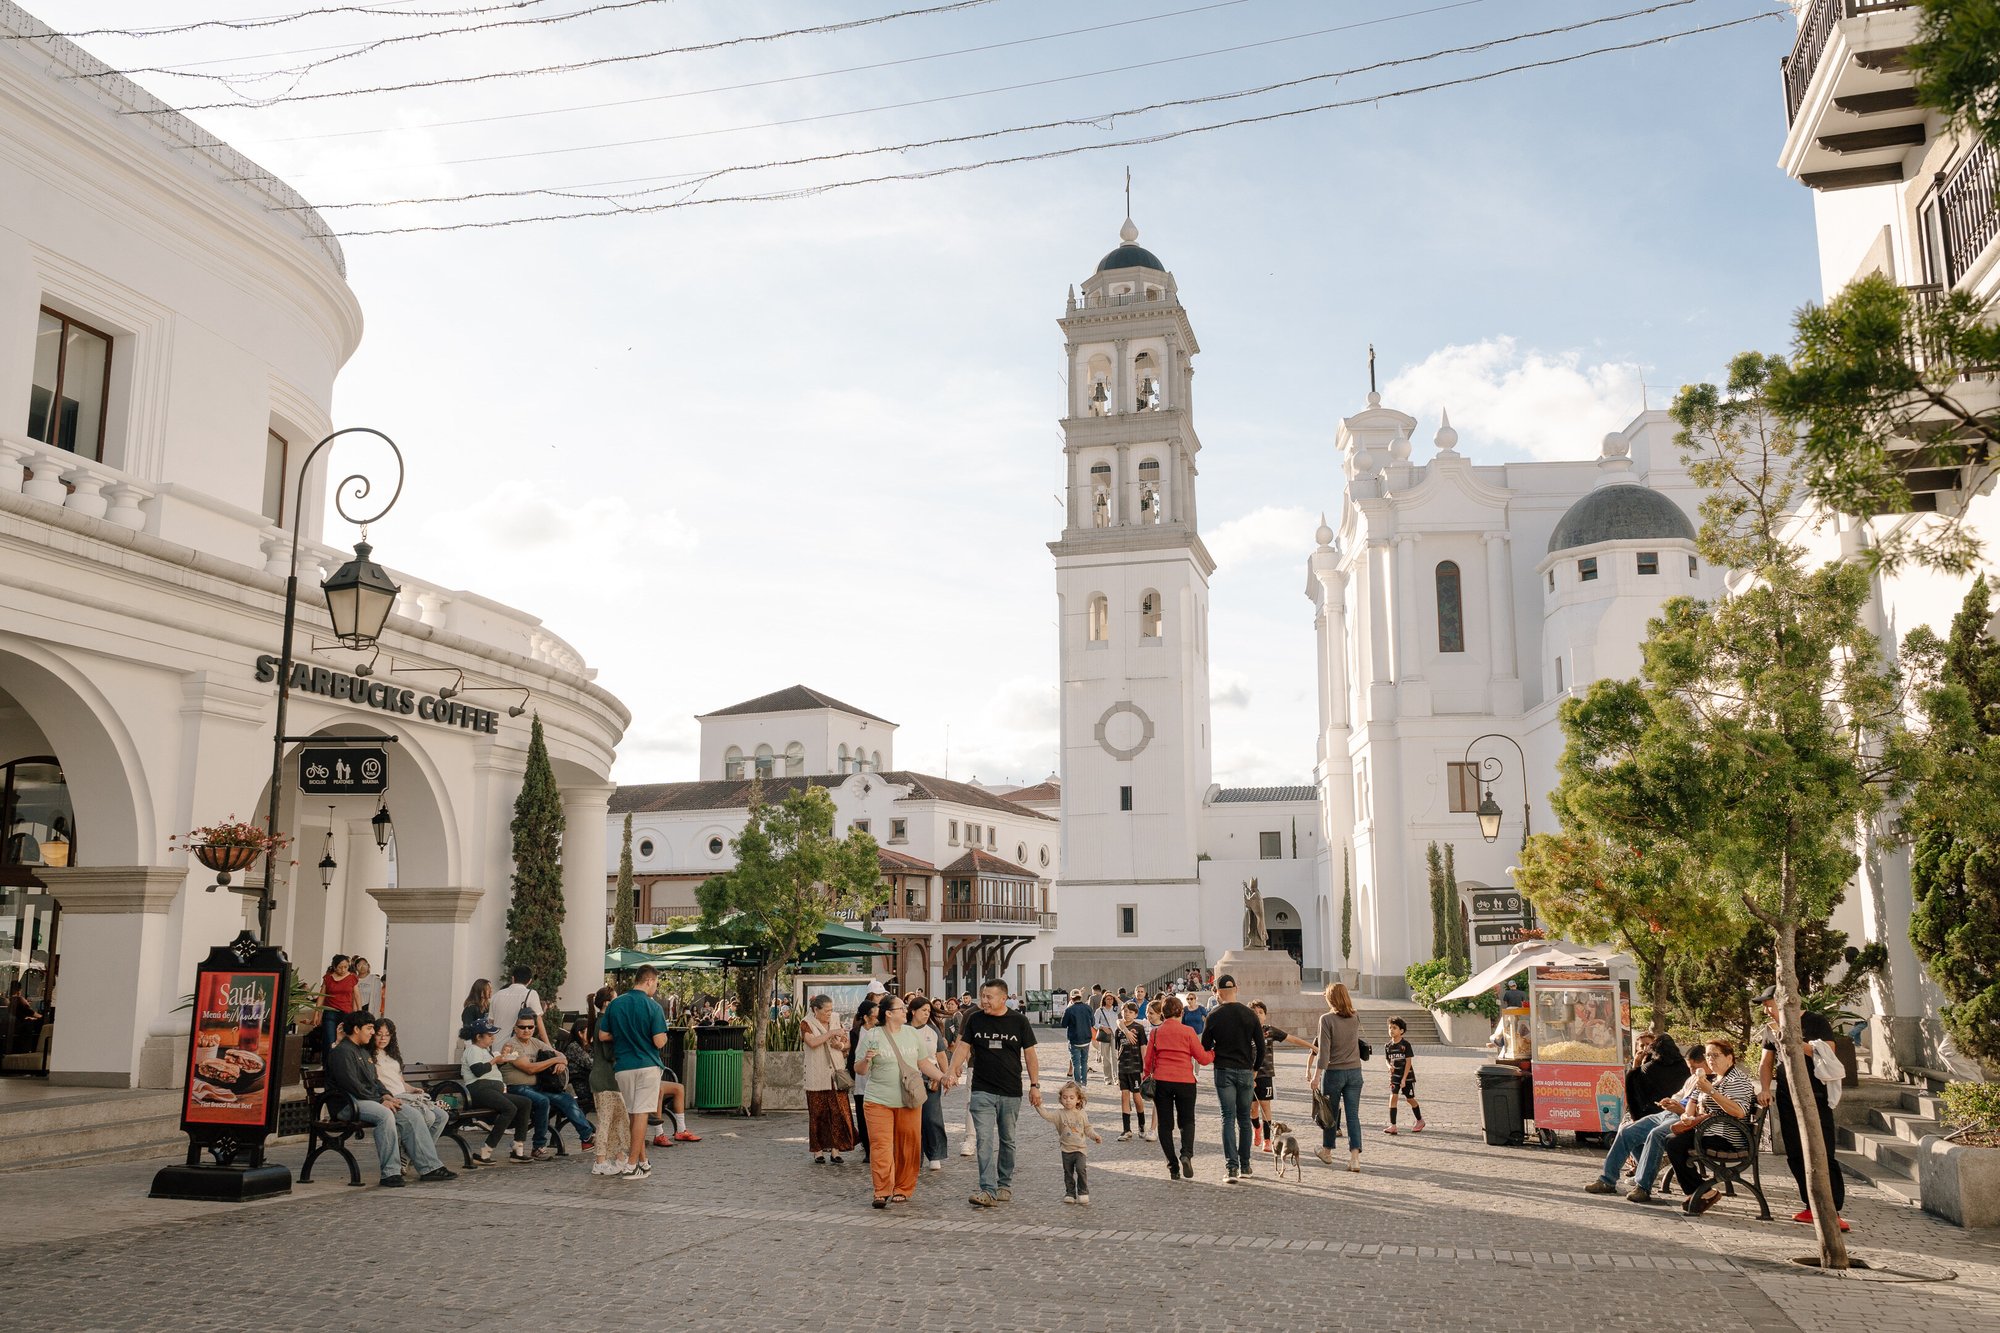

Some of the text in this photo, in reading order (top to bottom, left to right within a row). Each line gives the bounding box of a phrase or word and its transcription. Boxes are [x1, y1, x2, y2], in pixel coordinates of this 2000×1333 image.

[418, 696, 499, 734] COFFEE
[365, 761, 378, 771] 10
[218, 980, 257, 1006] Saúl
[202, 1010, 221, 1019] Menú
[222, 1010, 231, 1019] de
[974, 1032, 1018, 1042] ALPHA
[1534, 1087, 1592, 1098] POPOROPOS!
[1549, 1108, 1581, 1119] cinépolis
